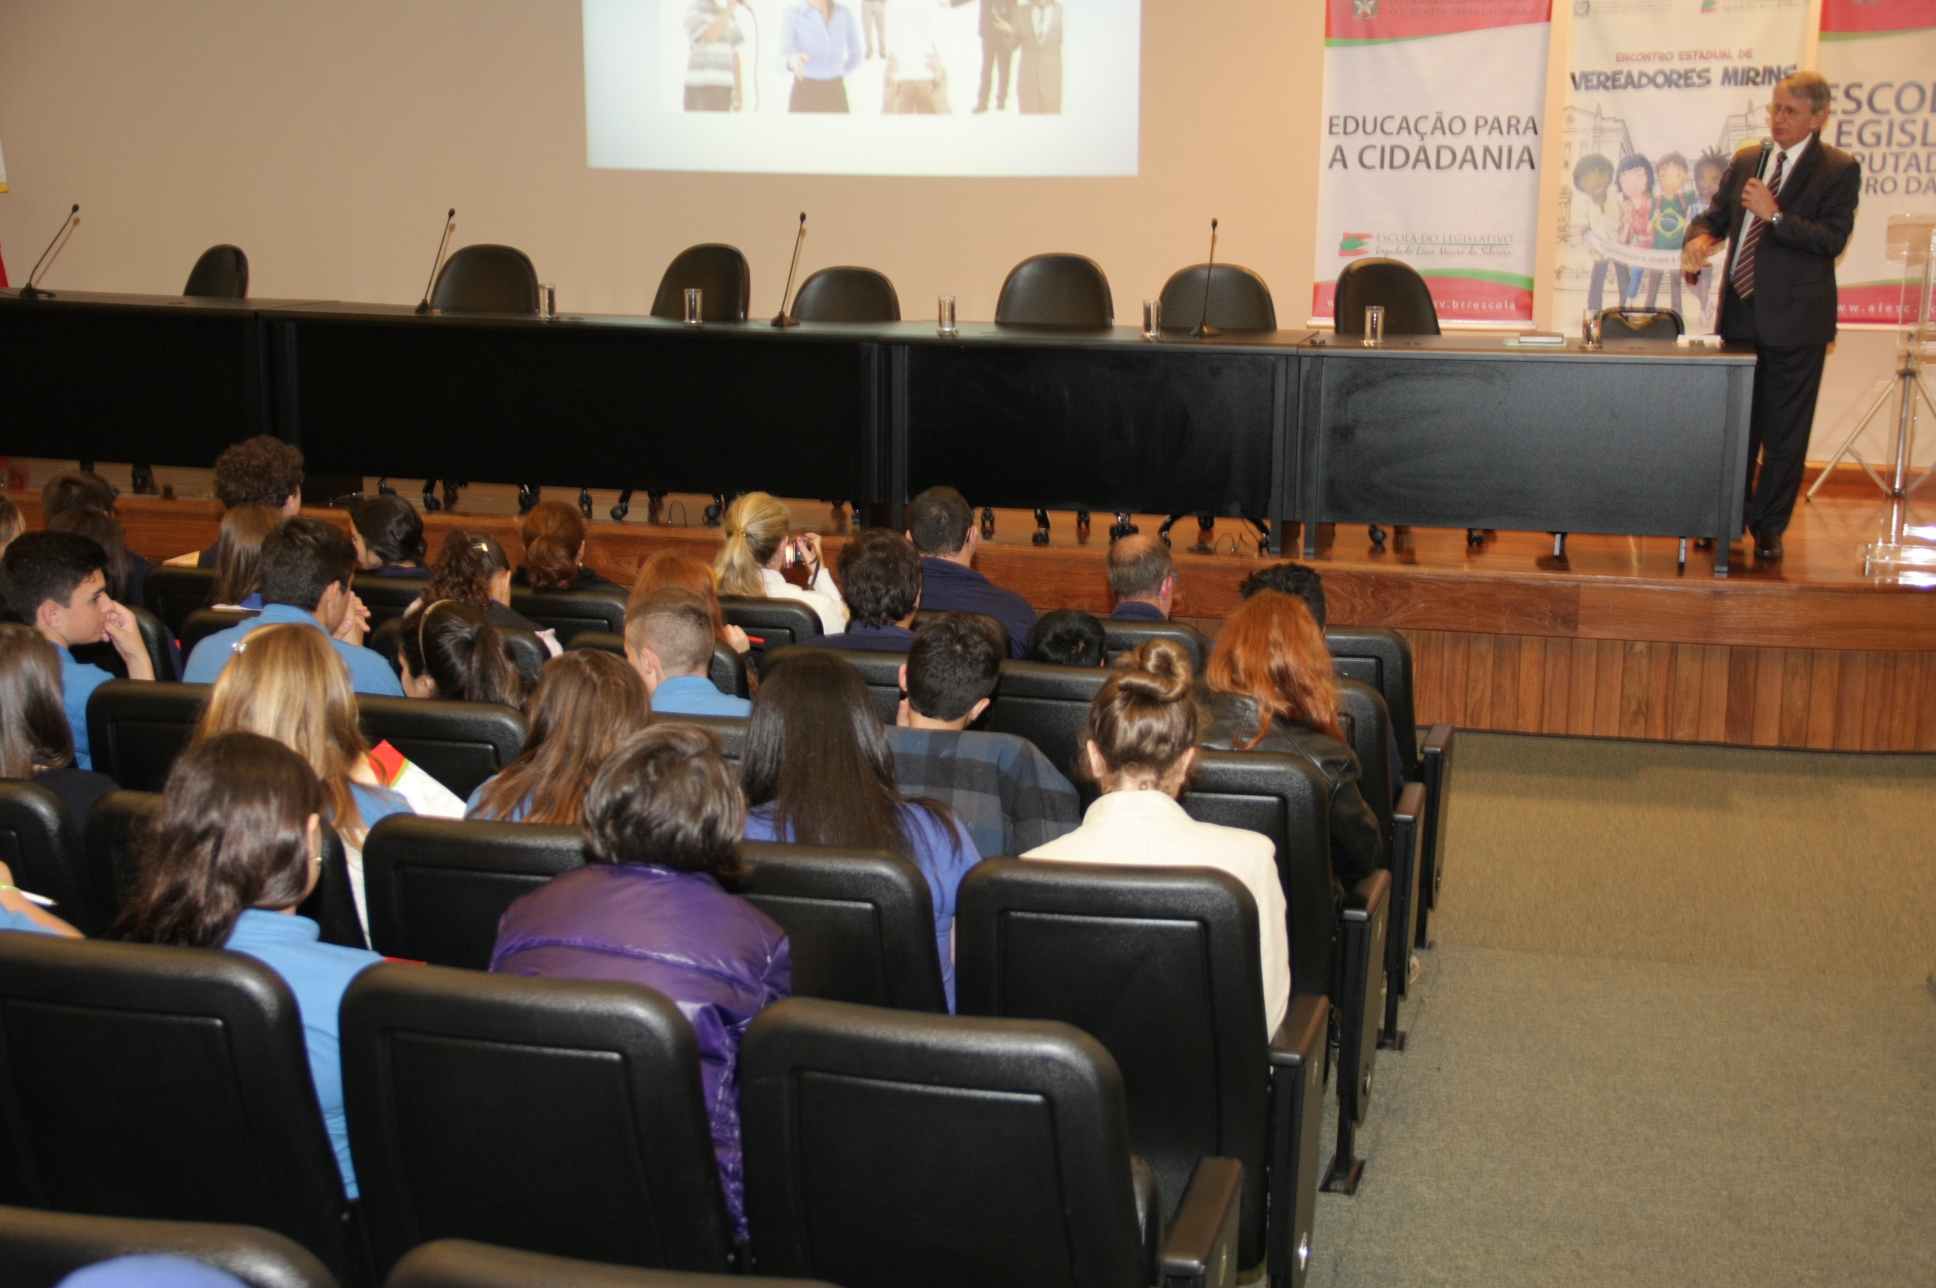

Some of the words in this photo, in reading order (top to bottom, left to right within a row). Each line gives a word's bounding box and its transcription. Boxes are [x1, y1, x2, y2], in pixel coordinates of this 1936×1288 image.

[1616, 52, 1673, 63] ENCONTRO
[1678, 50, 1733, 61] ESTADUAL
[1738, 48, 1753, 59] DE
[1570, 67, 1712, 91] VEREADORES
[1328, 111, 1466, 140] EDUCAÇÃO
[1474, 115, 1538, 136] PARA
[1328, 145, 1348, 169] A
[1358, 144, 1536, 170] CIDADANIA
[1376, 232, 1417, 243] ESCOLA
[1421, 233, 1439, 243] DO
[1442, 233, 1513, 243] LEGISLATIVO
[1375, 245, 1413, 257] Deputado
